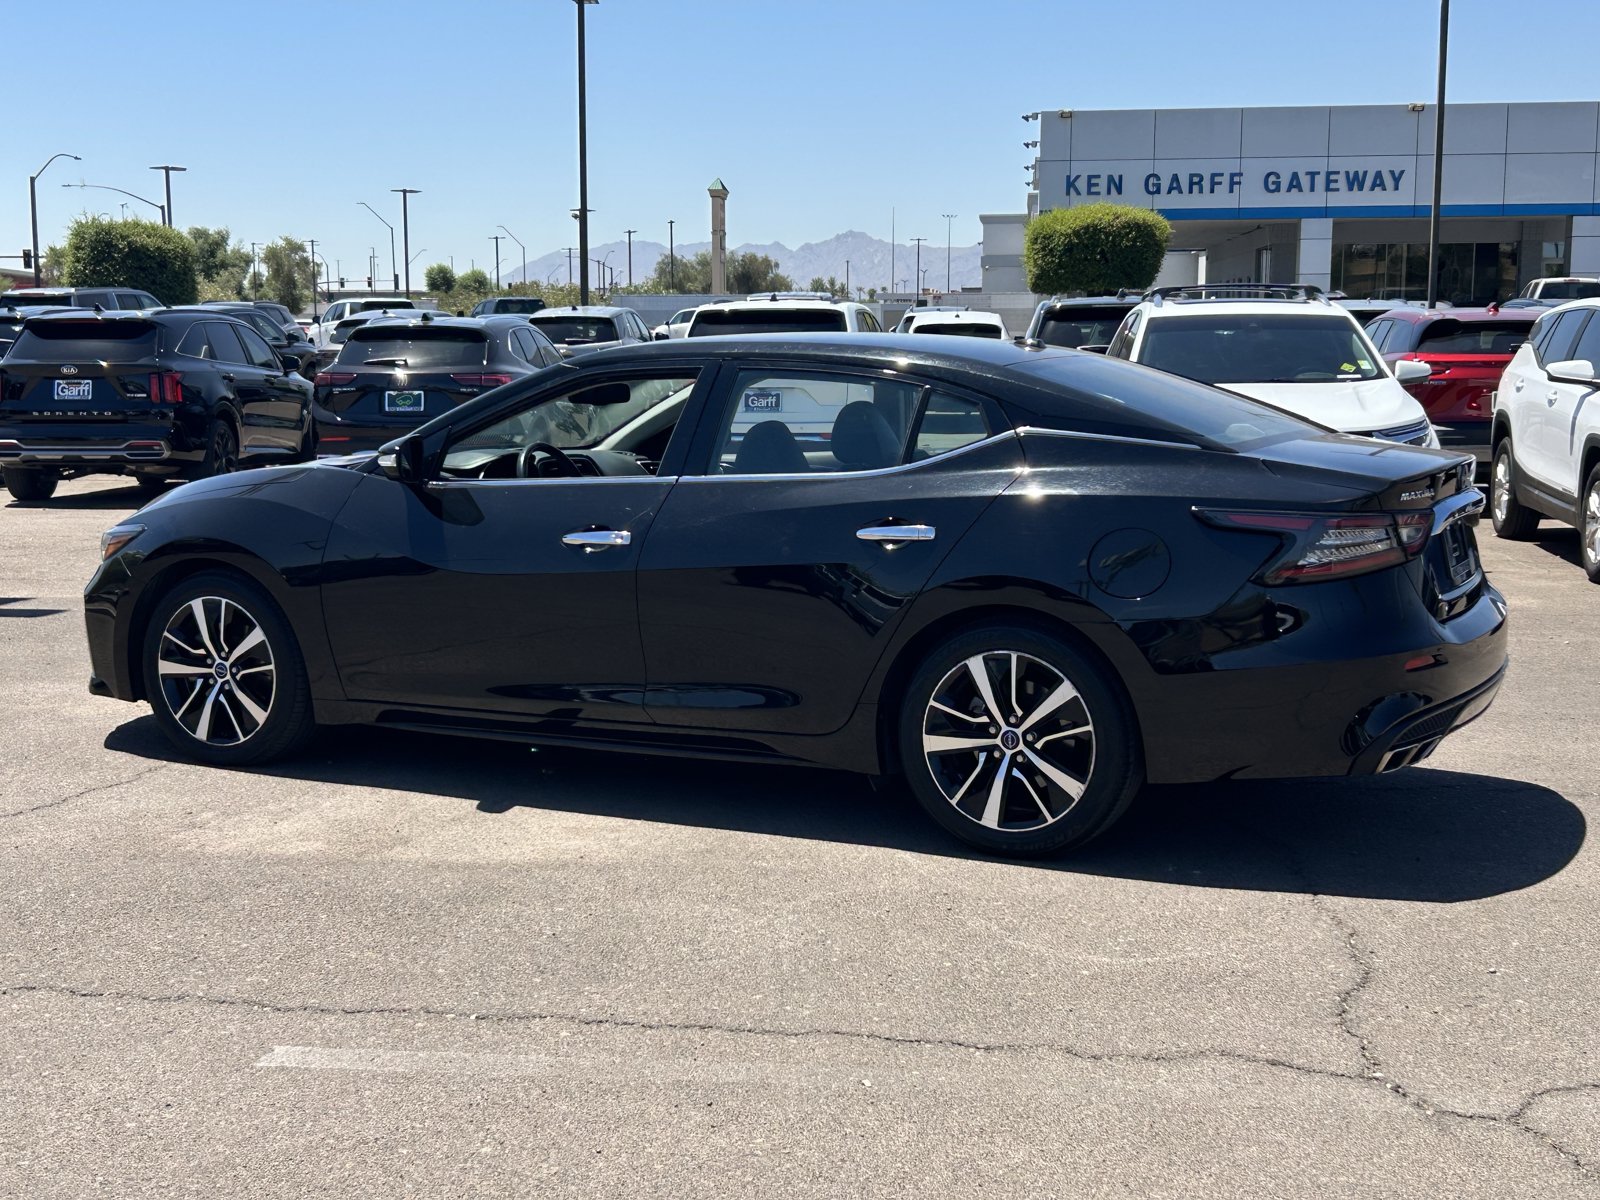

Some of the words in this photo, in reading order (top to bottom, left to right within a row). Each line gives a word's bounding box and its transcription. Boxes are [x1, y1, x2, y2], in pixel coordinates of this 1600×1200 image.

[1065, 174, 1123, 196] KEN
[1144, 172, 1243, 195] GARFF
[1263, 169, 1406, 193] GATEWAY
[58, 384, 90, 396] Garff
[748, 396, 777, 407] Garff
